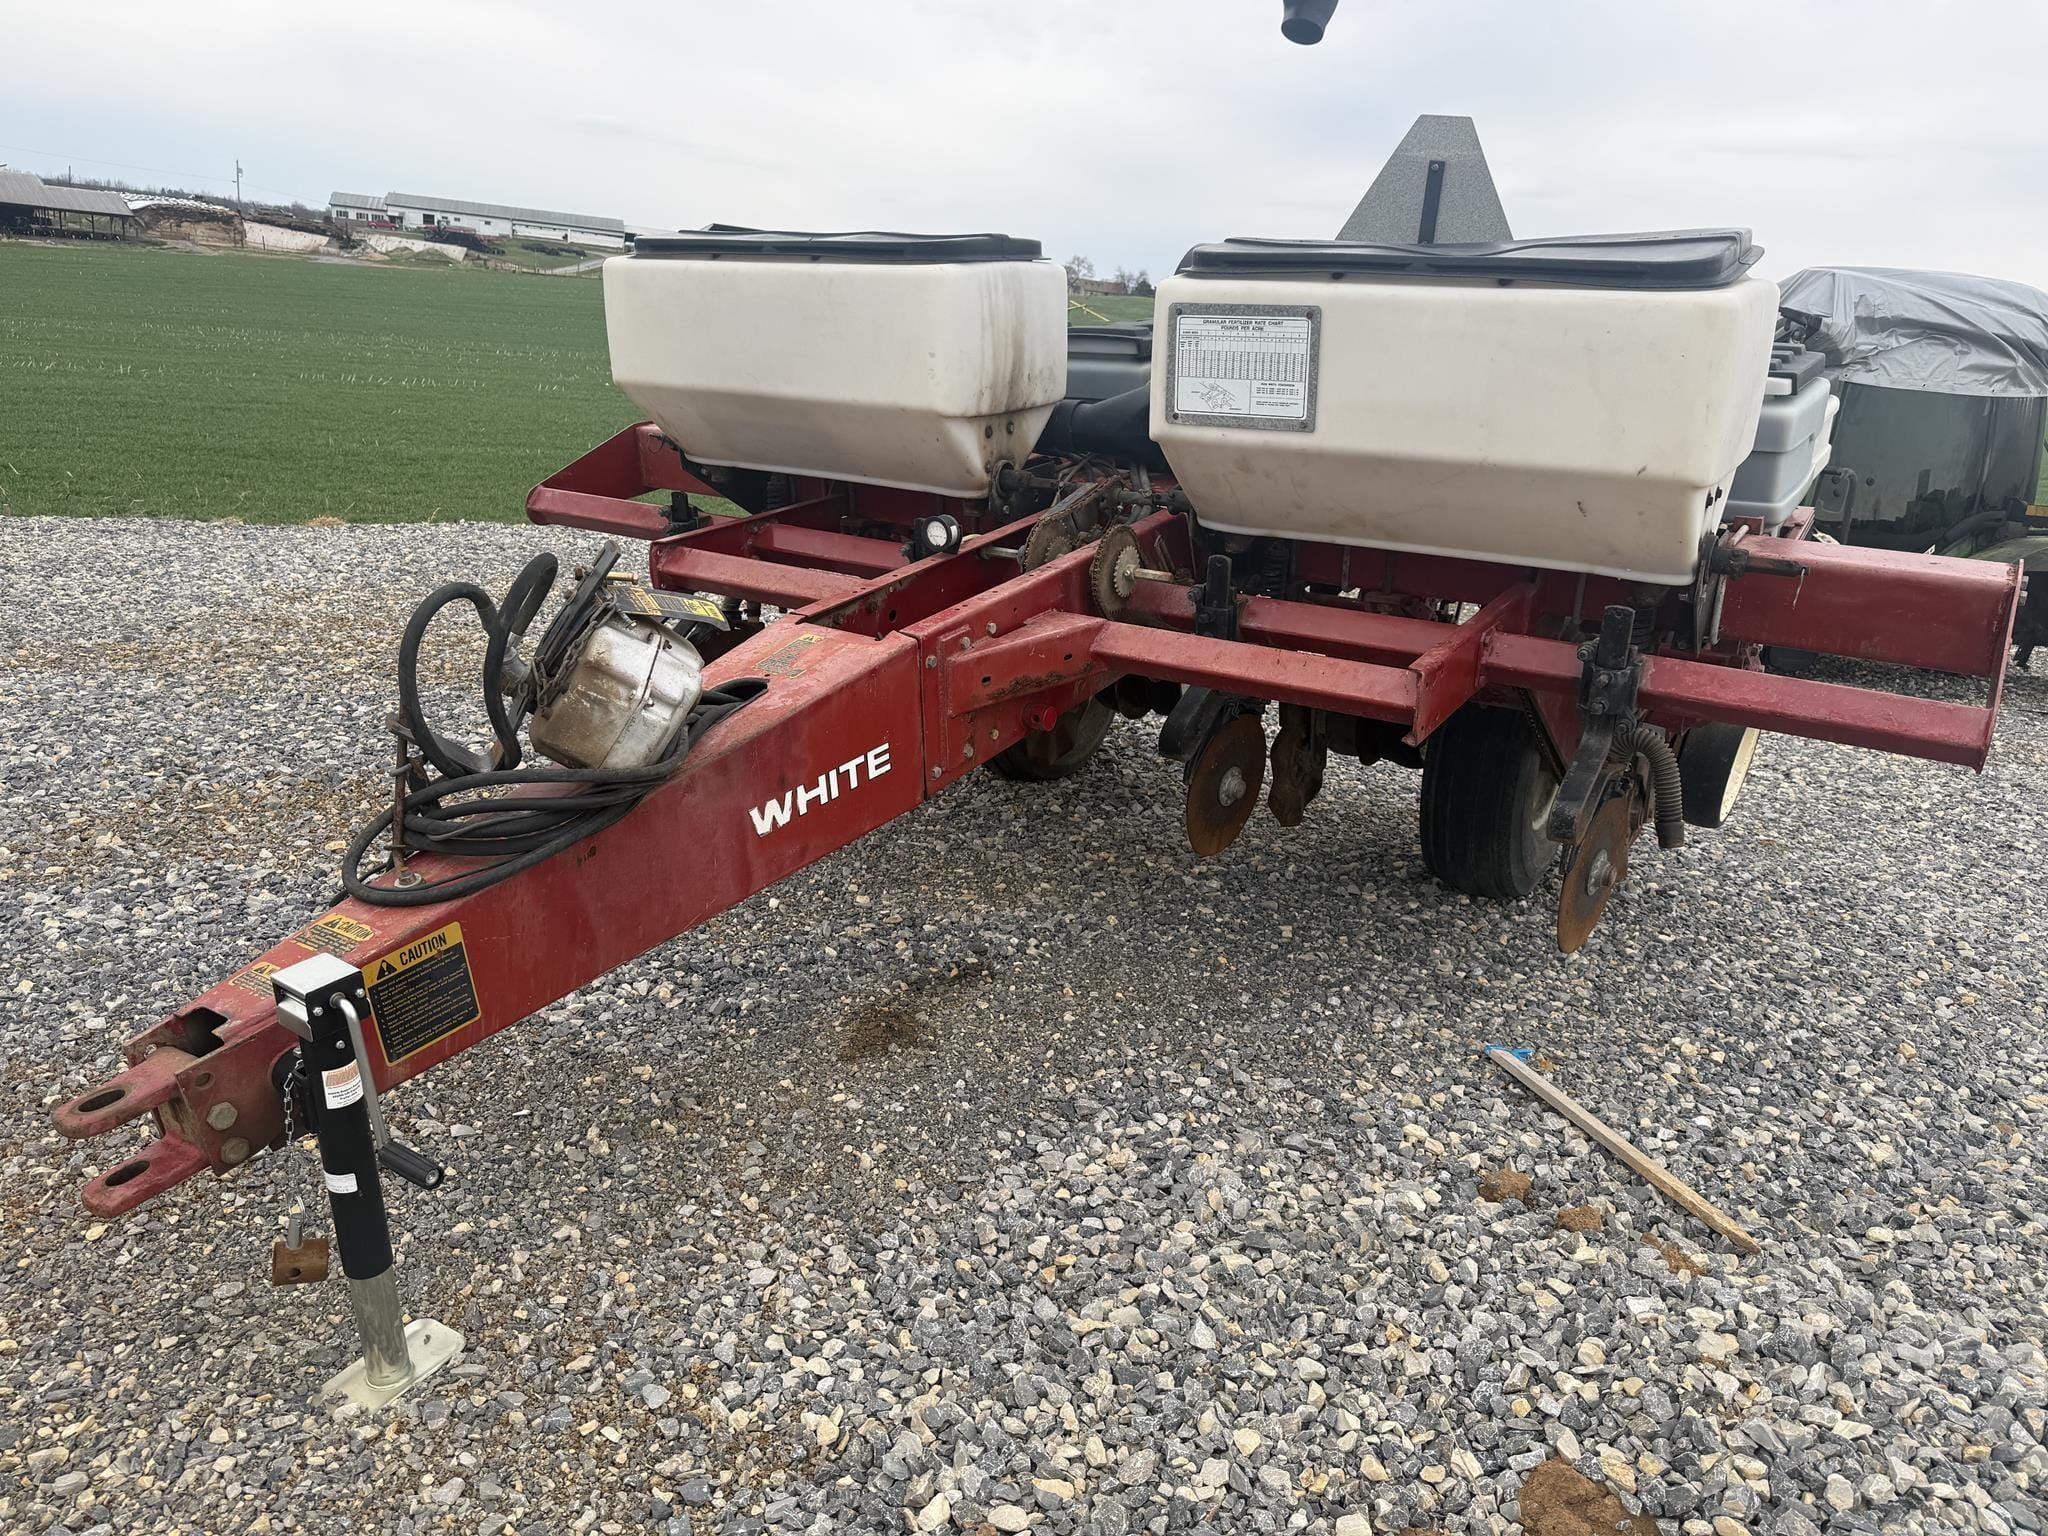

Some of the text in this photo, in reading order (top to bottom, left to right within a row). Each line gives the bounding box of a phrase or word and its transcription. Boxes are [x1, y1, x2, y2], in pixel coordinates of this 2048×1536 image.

[748, 743, 892, 837] WHITE
[338, 920, 374, 940] CAUTION
[399, 932, 447, 966] CAUTION
